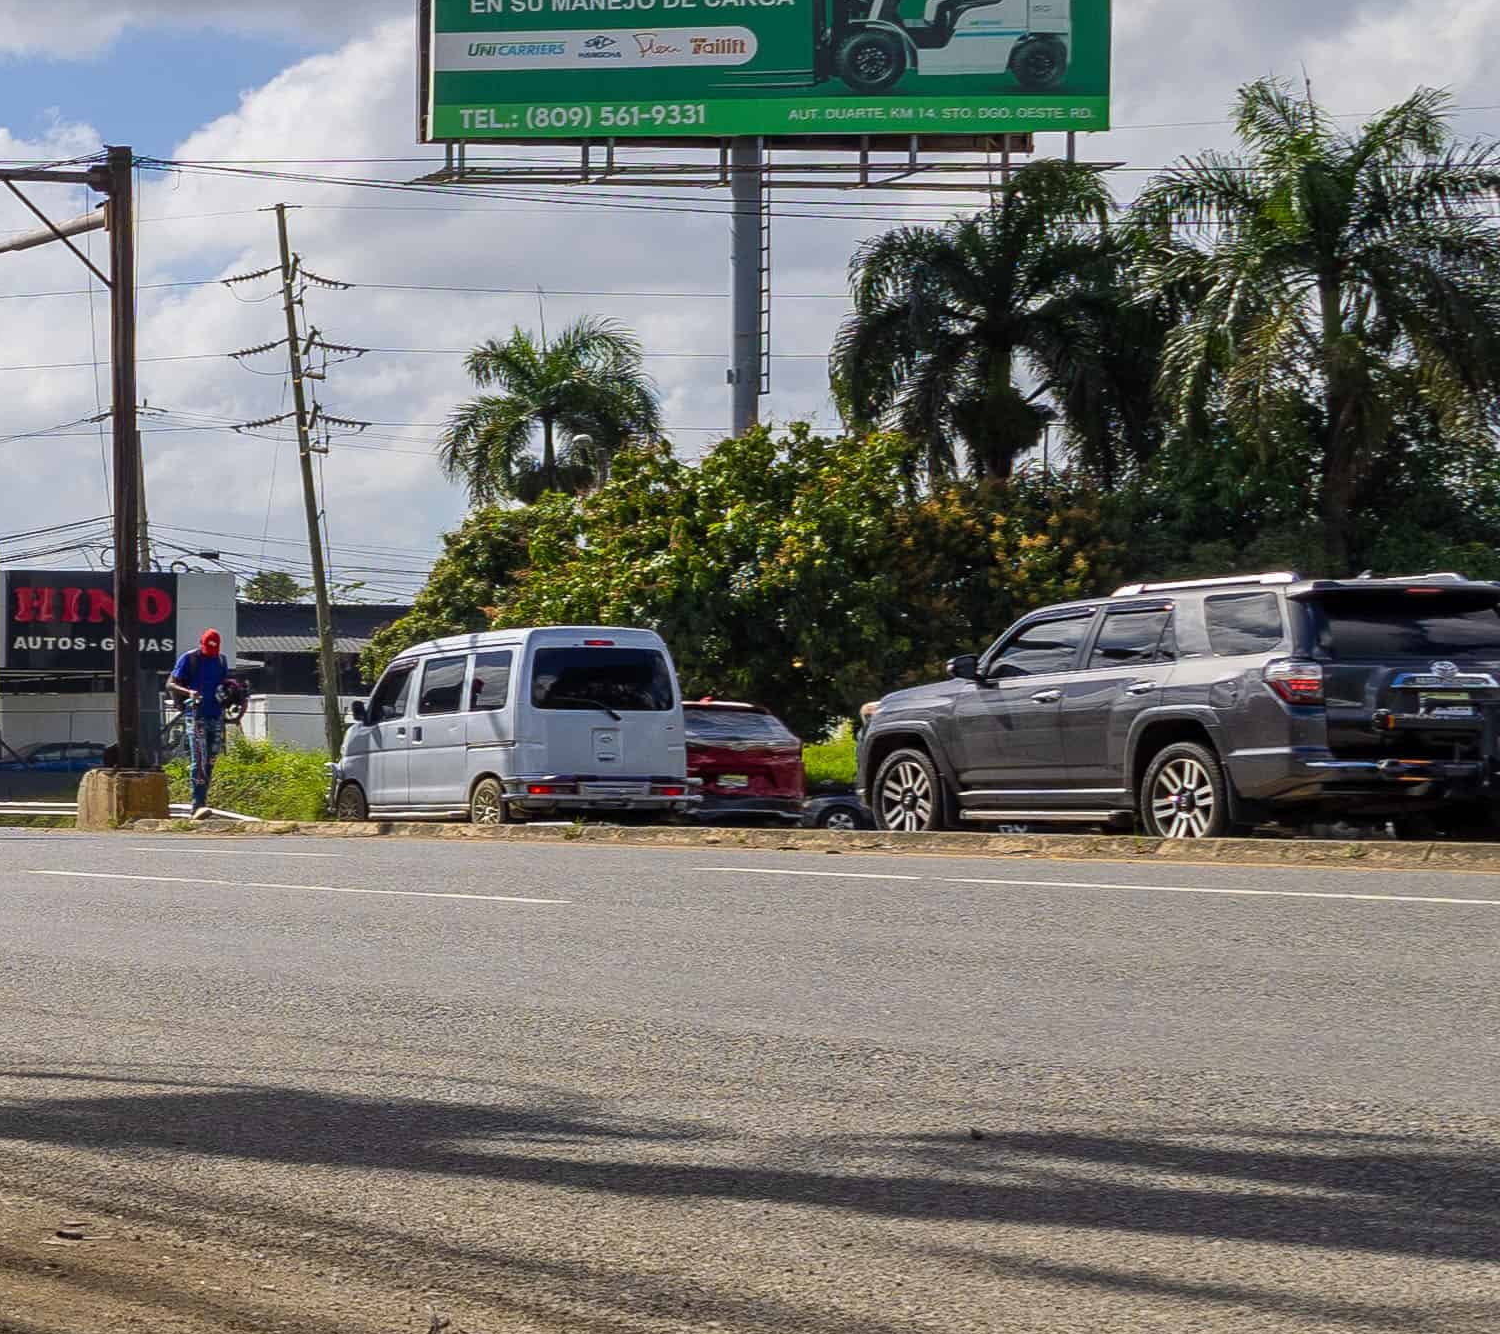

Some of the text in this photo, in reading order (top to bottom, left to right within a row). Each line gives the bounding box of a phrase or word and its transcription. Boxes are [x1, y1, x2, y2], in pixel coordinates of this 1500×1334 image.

[690, 37, 746, 55] Tailift
[459, 104, 706, 129] TEL.: (809) 561-9331
[891, 107, 913, 119] KM
